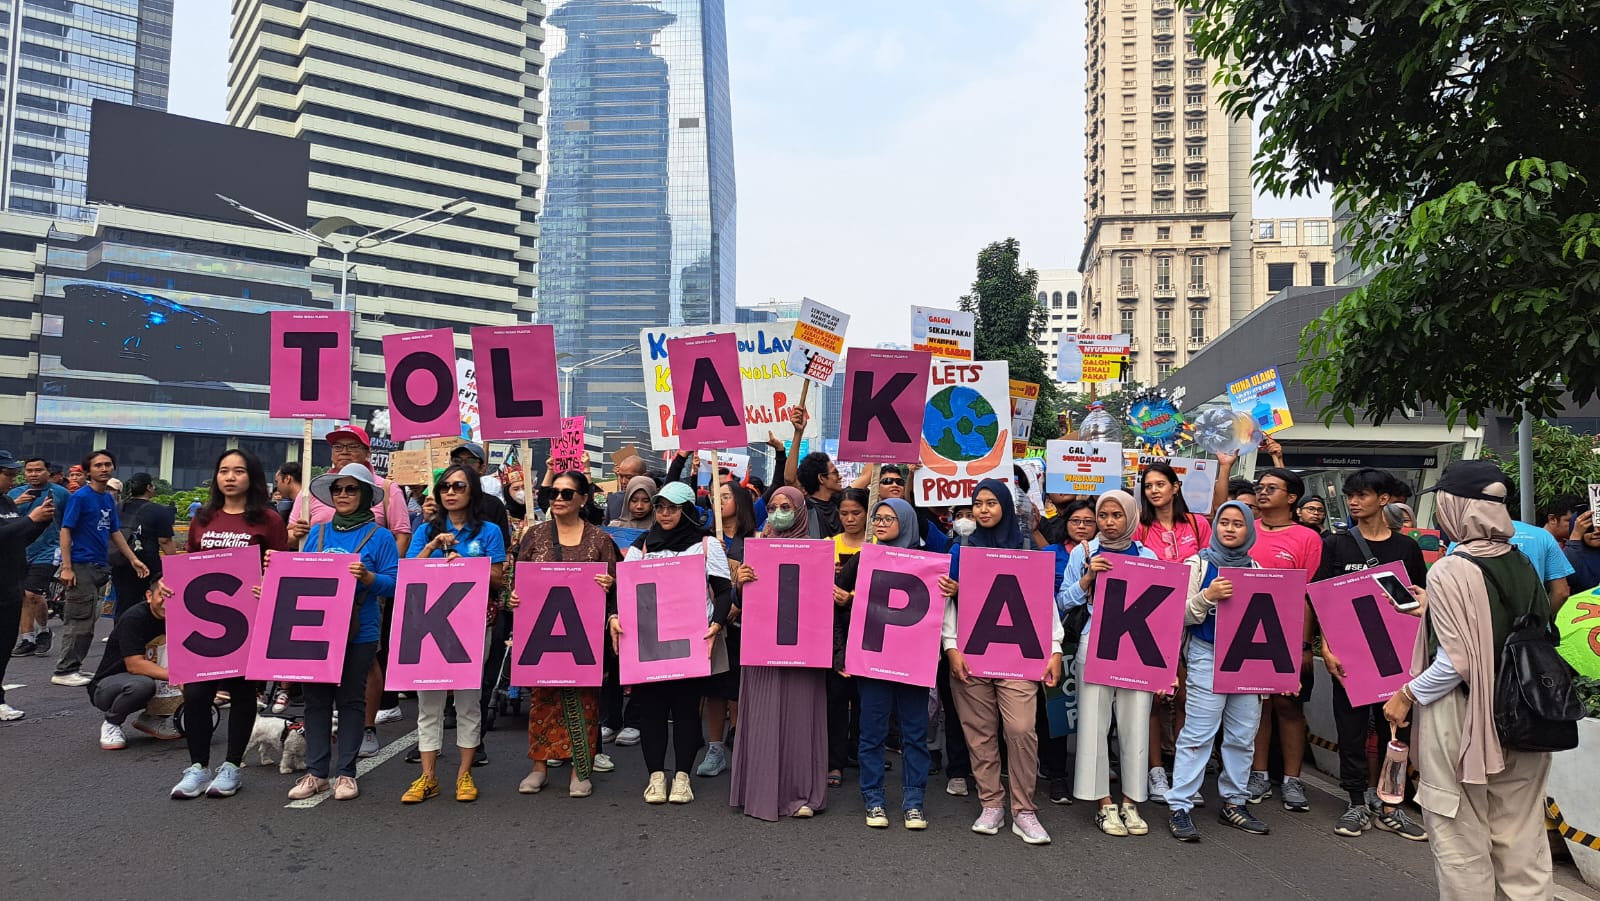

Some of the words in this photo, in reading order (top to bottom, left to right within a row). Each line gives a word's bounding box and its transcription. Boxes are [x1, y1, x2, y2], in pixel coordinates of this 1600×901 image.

[929, 316, 950, 324] GALON
[929, 326, 950, 334] SEKALI
[952, 329, 971, 337] PAKAI
[284, 332, 338, 401] T
[390, 352, 454, 423] O
[490, 348, 543, 418] L
[682, 357, 741, 430] A
[808, 368, 826, 380] PAKAI
[811, 362, 832, 374] SEKALI
[814, 354, 832, 366] TOLAK
[932, 364, 983, 385] LETS
[1230, 379, 1250, 394] GUNA
[1251, 368, 1276, 386] ULANG
[848, 370, 918, 443] K
[182, 572, 249, 658] S
[266, 577, 338, 660] E
[398, 582, 476, 664] K
[518, 586, 596, 665] A
[636, 582, 690, 662] L
[777, 564, 800, 645] I
[862, 569, 930, 652] P
[964, 574, 1044, 659] A
[1097, 578, 1176, 668] K
[1220, 593, 1295, 673] A
[1352, 594, 1403, 678] I
